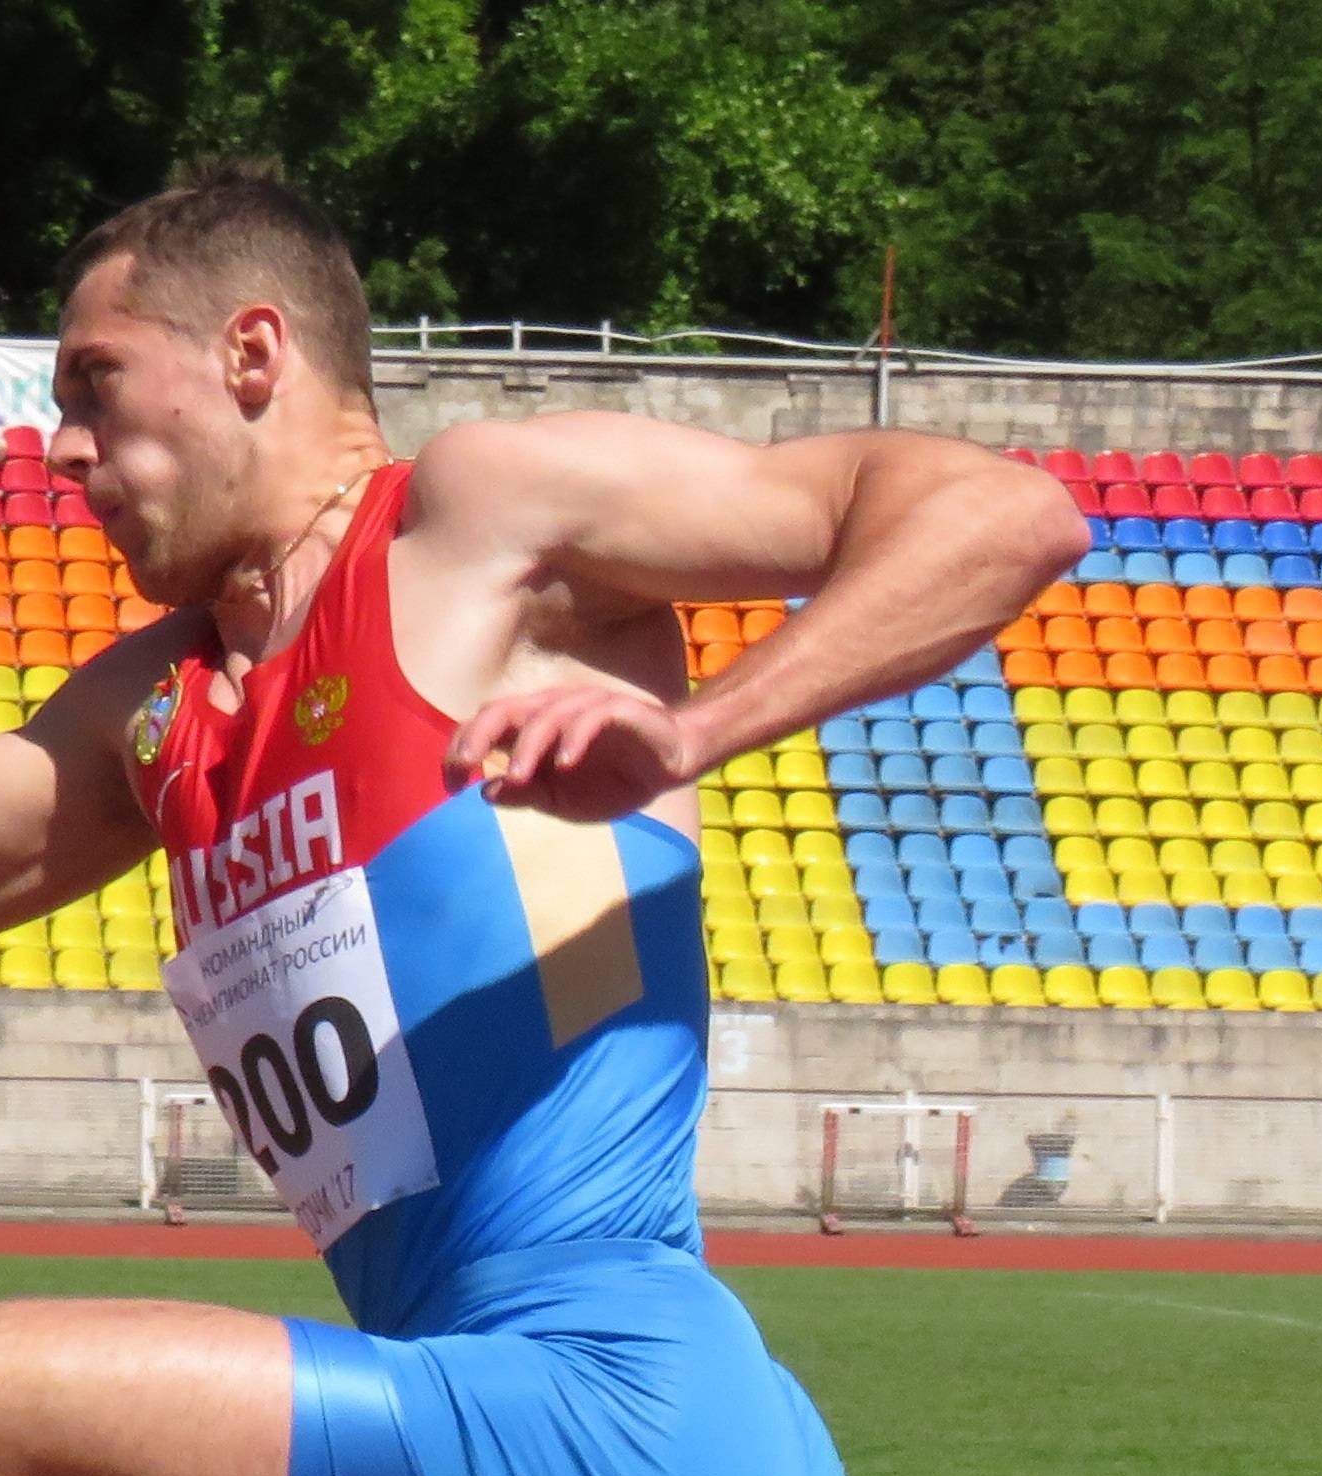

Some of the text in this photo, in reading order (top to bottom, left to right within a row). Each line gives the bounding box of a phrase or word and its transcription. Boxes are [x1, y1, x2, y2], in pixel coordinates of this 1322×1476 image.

[200, 900, 317, 980] КОМАНДНЫЙ
[282, 923, 366, 977] РОССИИ
[719, 1029, 750, 1073] 3
[207, 996, 379, 1178] 200
